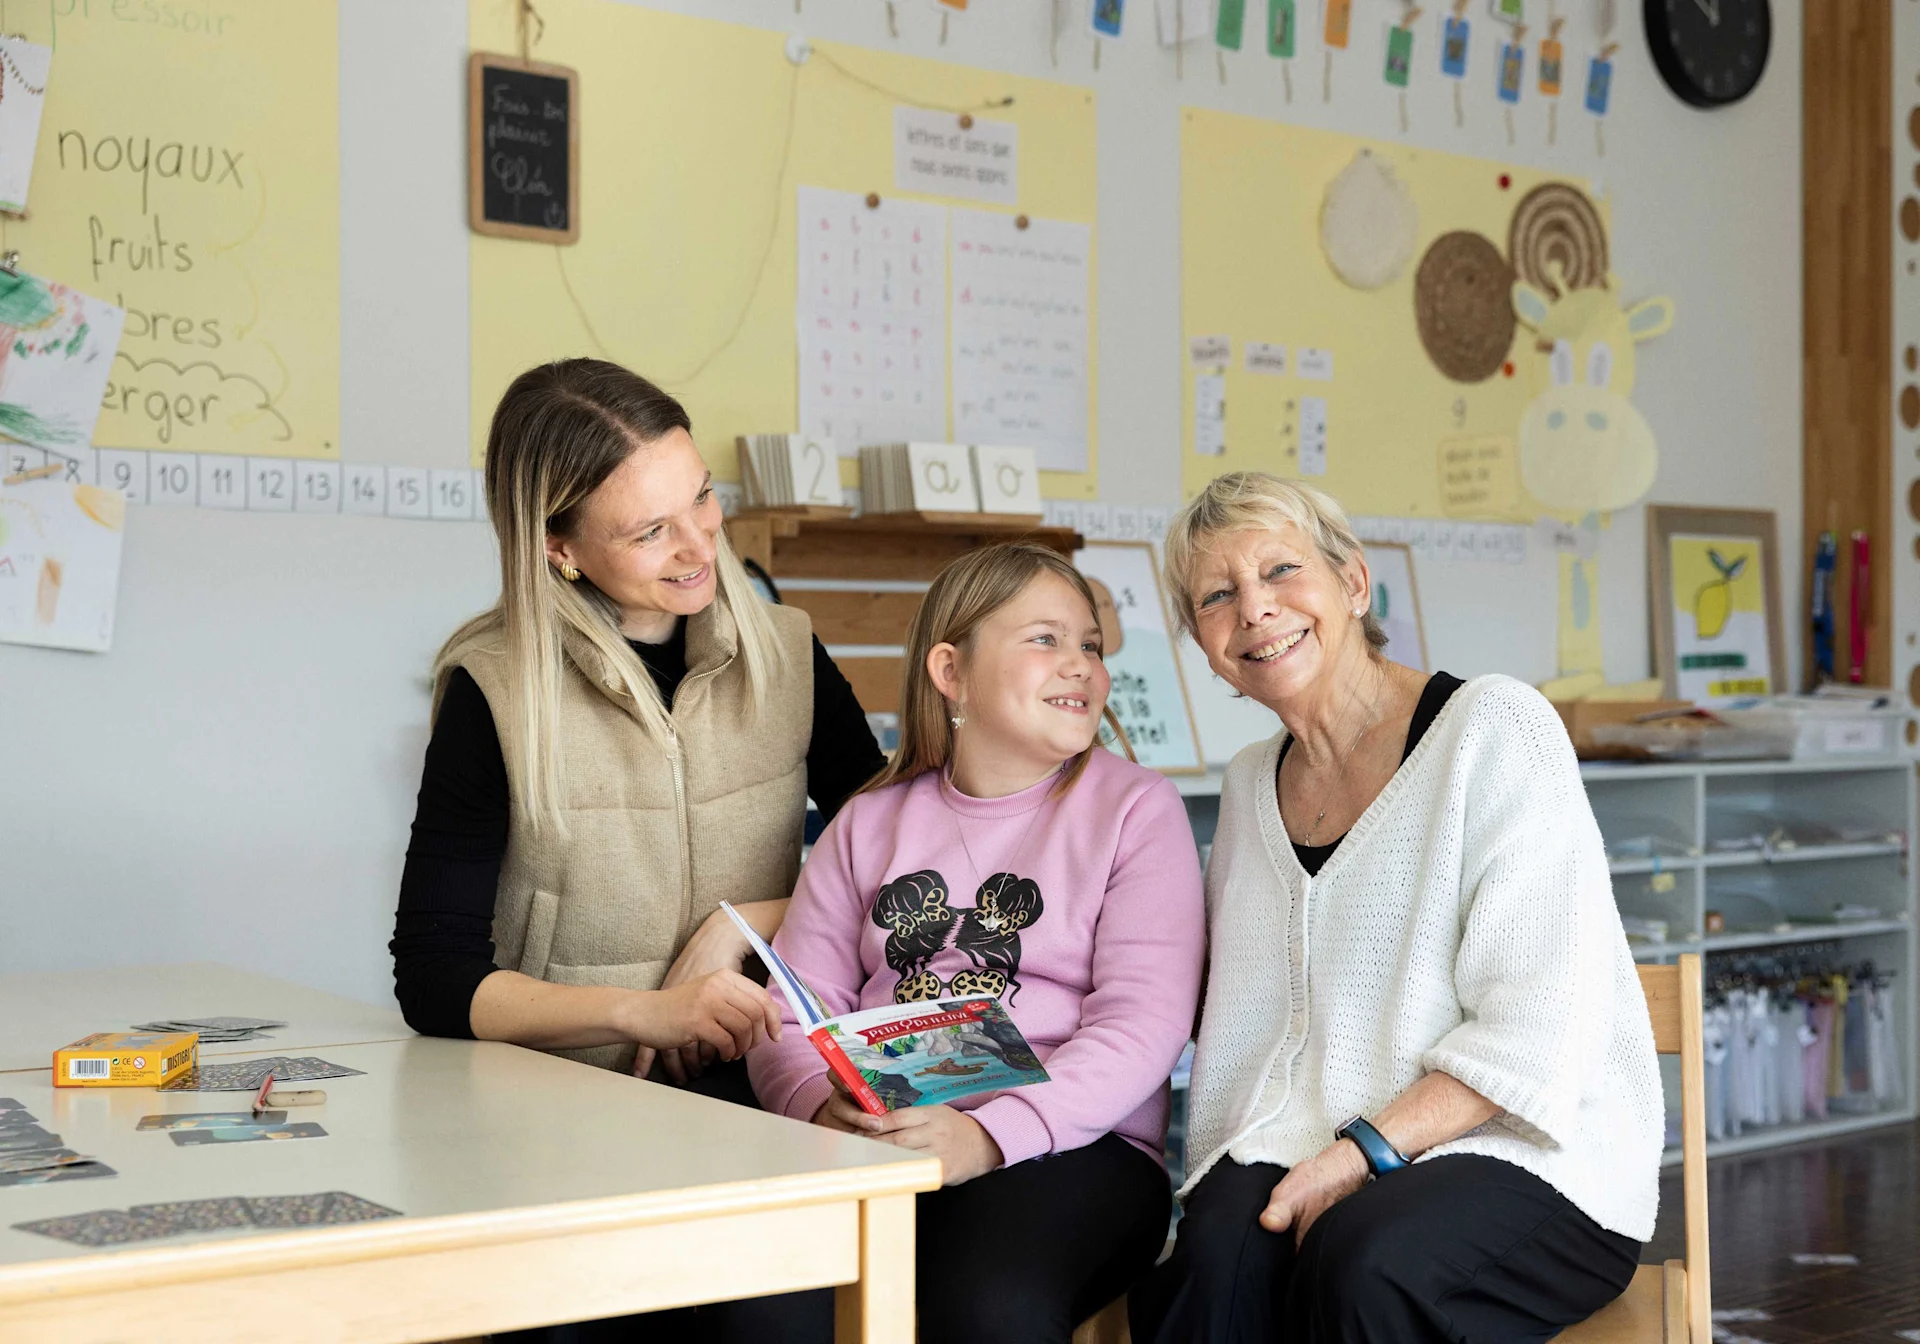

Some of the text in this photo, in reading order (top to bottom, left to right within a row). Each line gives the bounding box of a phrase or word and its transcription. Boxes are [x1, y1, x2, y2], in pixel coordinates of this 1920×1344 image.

[58, 130, 244, 215] noyaux
[89, 214, 193, 282] fruits
[117, 292, 222, 348] bres
[102, 382, 220, 443] erger
[114, 461, 132, 489] 9
[159, 464, 189, 494] 10
[213, 468, 233, 494] 11
[259, 469, 284, 498] 12
[803, 442, 828, 500] 2
[922, 460, 960, 494] a
[305, 472, 331, 500] 13
[353, 476, 376, 502] 14
[397, 477, 420, 505] 15
[440, 480, 465, 507] 16
[1111, 670, 1147, 693] che
